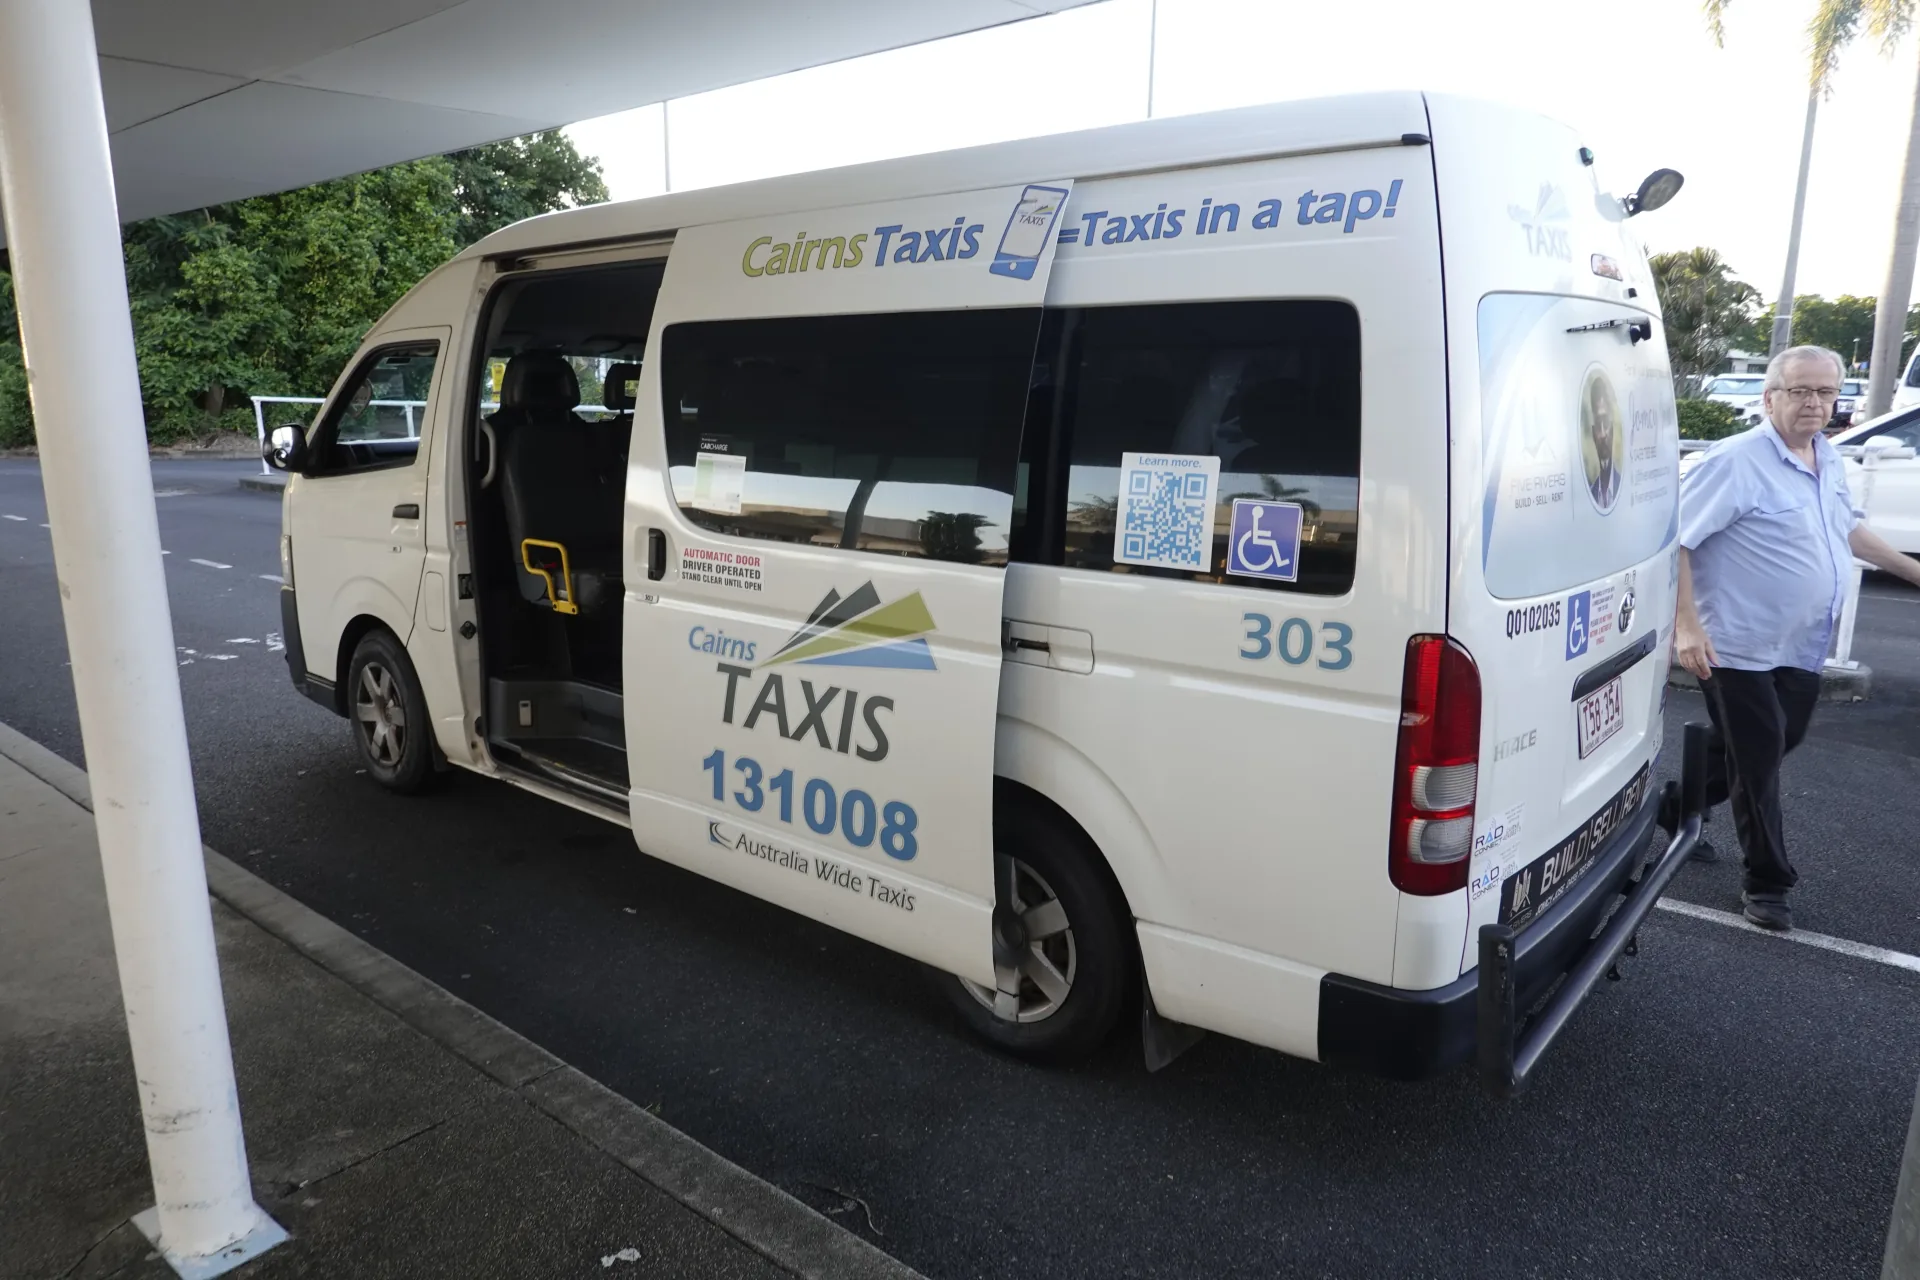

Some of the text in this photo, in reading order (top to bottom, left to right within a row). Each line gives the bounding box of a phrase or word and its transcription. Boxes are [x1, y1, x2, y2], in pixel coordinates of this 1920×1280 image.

[742, 231, 868, 278] Cairns
[873, 218, 984, 267] Taxis
[1196, 198, 1240, 235] in
[1251, 199, 1282, 230] a
[1297, 179, 1404, 234] tap!
[1019, 214, 1046, 226] TAXIS
[1520, 222, 1573, 264] TAXIS
[700, 442, 728, 452] CABCHARGE
[1139, 455, 1202, 469] Learn more.
[1511, 473, 1566, 495] FIVE RIVERS
[1515, 497, 1532, 509] BUILD
[1535, 495, 1548, 506] SELL
[682, 560, 761, 580] DRIVER OPERATED
[684, 548, 760, 567] AUTOMATIC DOOR
[681, 571, 761, 592] STAND CLEAR UNTIL OPEN
[688, 626, 757, 662] Cairns
[1239, 612, 1354, 671] 303
[717, 662, 895, 762] TAXIS
[1493, 728, 1537, 763] HIACE
[702, 748, 919, 862] 131008
[1474, 836, 1502, 857] CONNECT
[1475, 825, 1504, 850] RAD
[736, 833, 915, 912] Australia Wide Taxis
[1472, 866, 1500, 893] RAD
